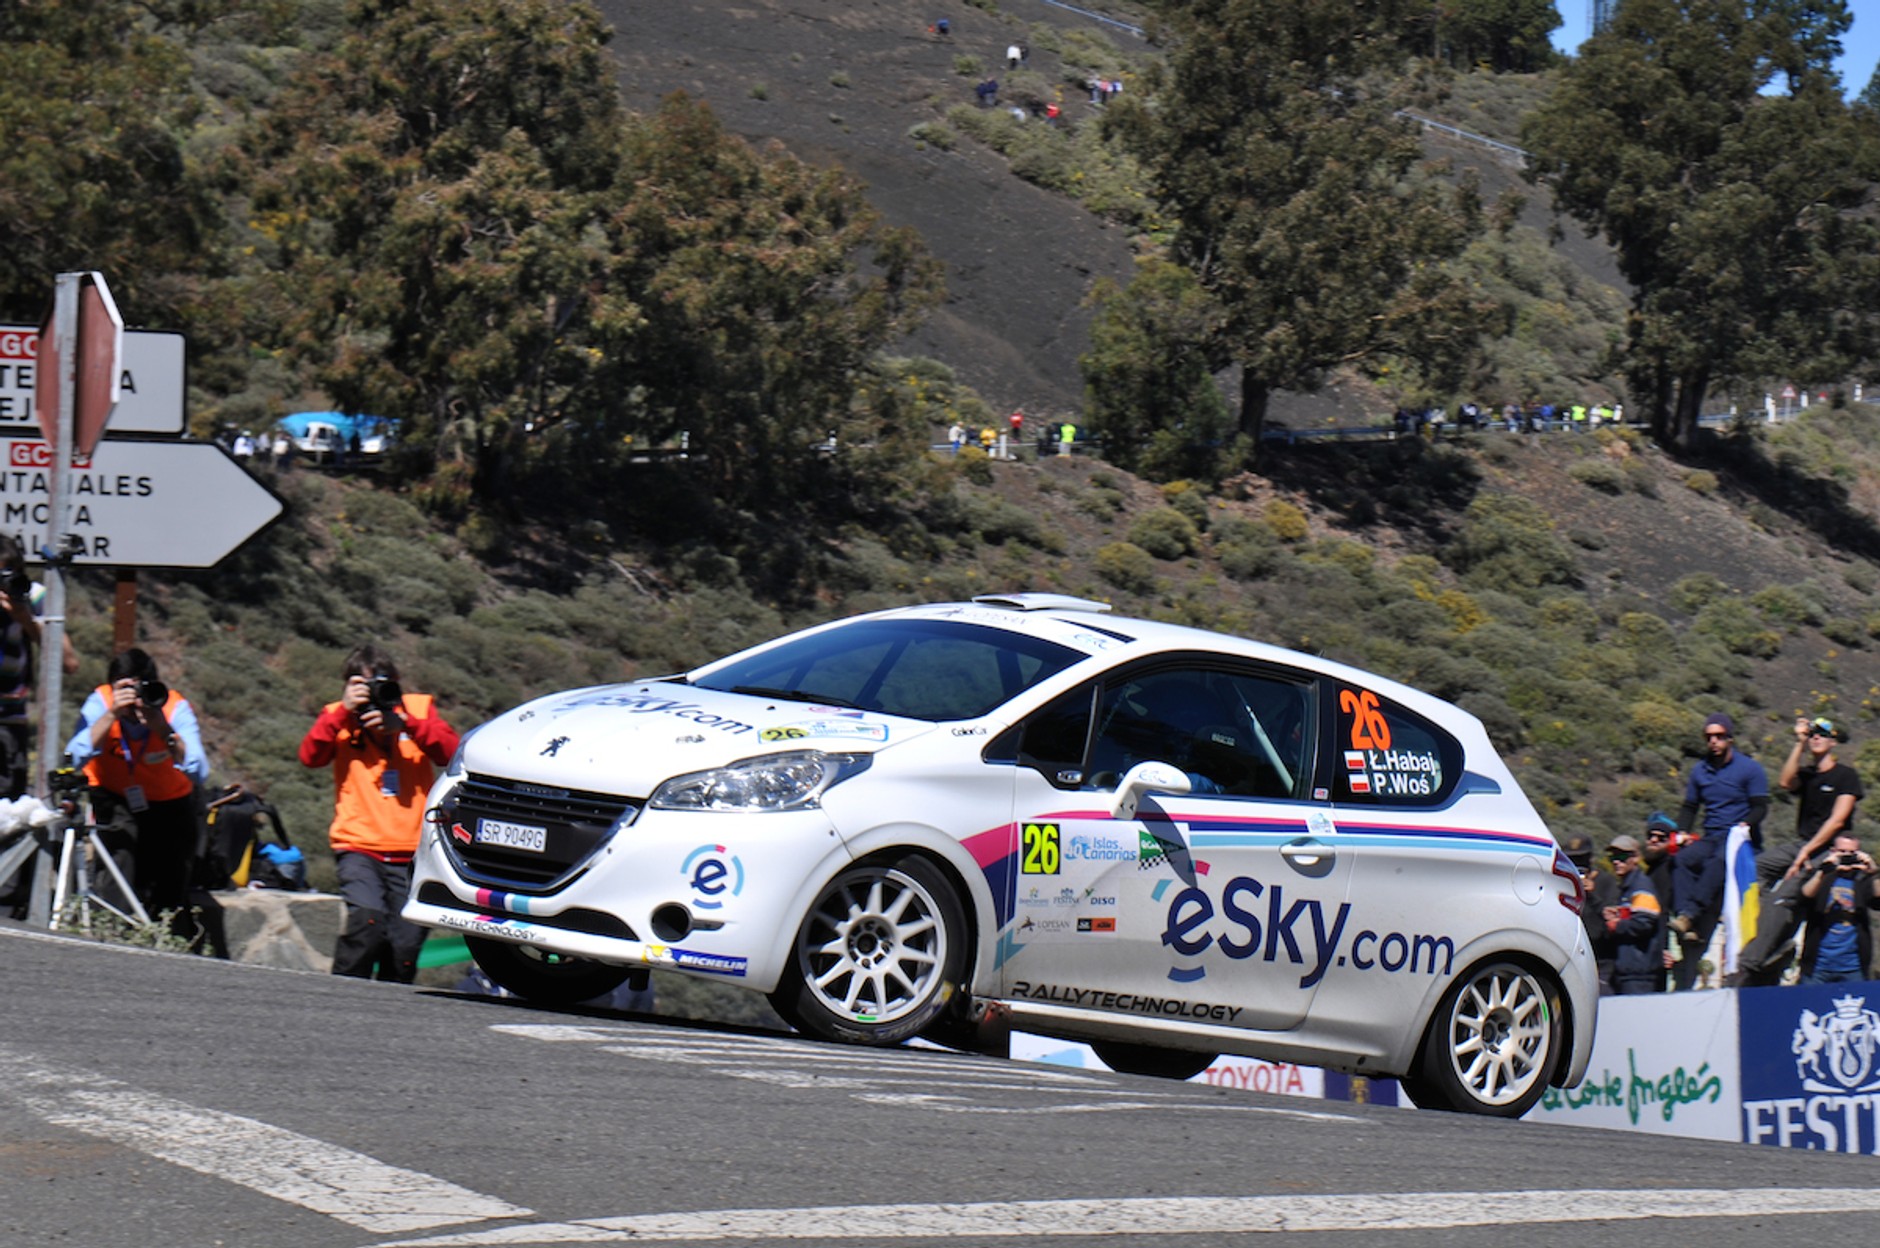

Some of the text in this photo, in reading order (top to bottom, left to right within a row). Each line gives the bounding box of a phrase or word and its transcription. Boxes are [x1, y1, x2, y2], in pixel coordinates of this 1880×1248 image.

[1340, 690, 1392, 750] 26
[767, 728, 804, 741] 26
[1369, 750, 1437, 776] Ł.Habaj
[1373, 773, 1430, 795] P.Woś
[483, 822, 543, 849] SR 9049G
[1093, 837, 1119, 850] Islas
[1024, 824, 1059, 874] 26
[1084, 847, 1137, 861] Canarias
[439, 914, 537, 942] RALLYTECHNOLOGY
[1161, 876, 1455, 989] eSky.com
[679, 954, 747, 971] MICHELIN
[1010, 980, 1245, 1022] RALLYTECHNOLOGY
